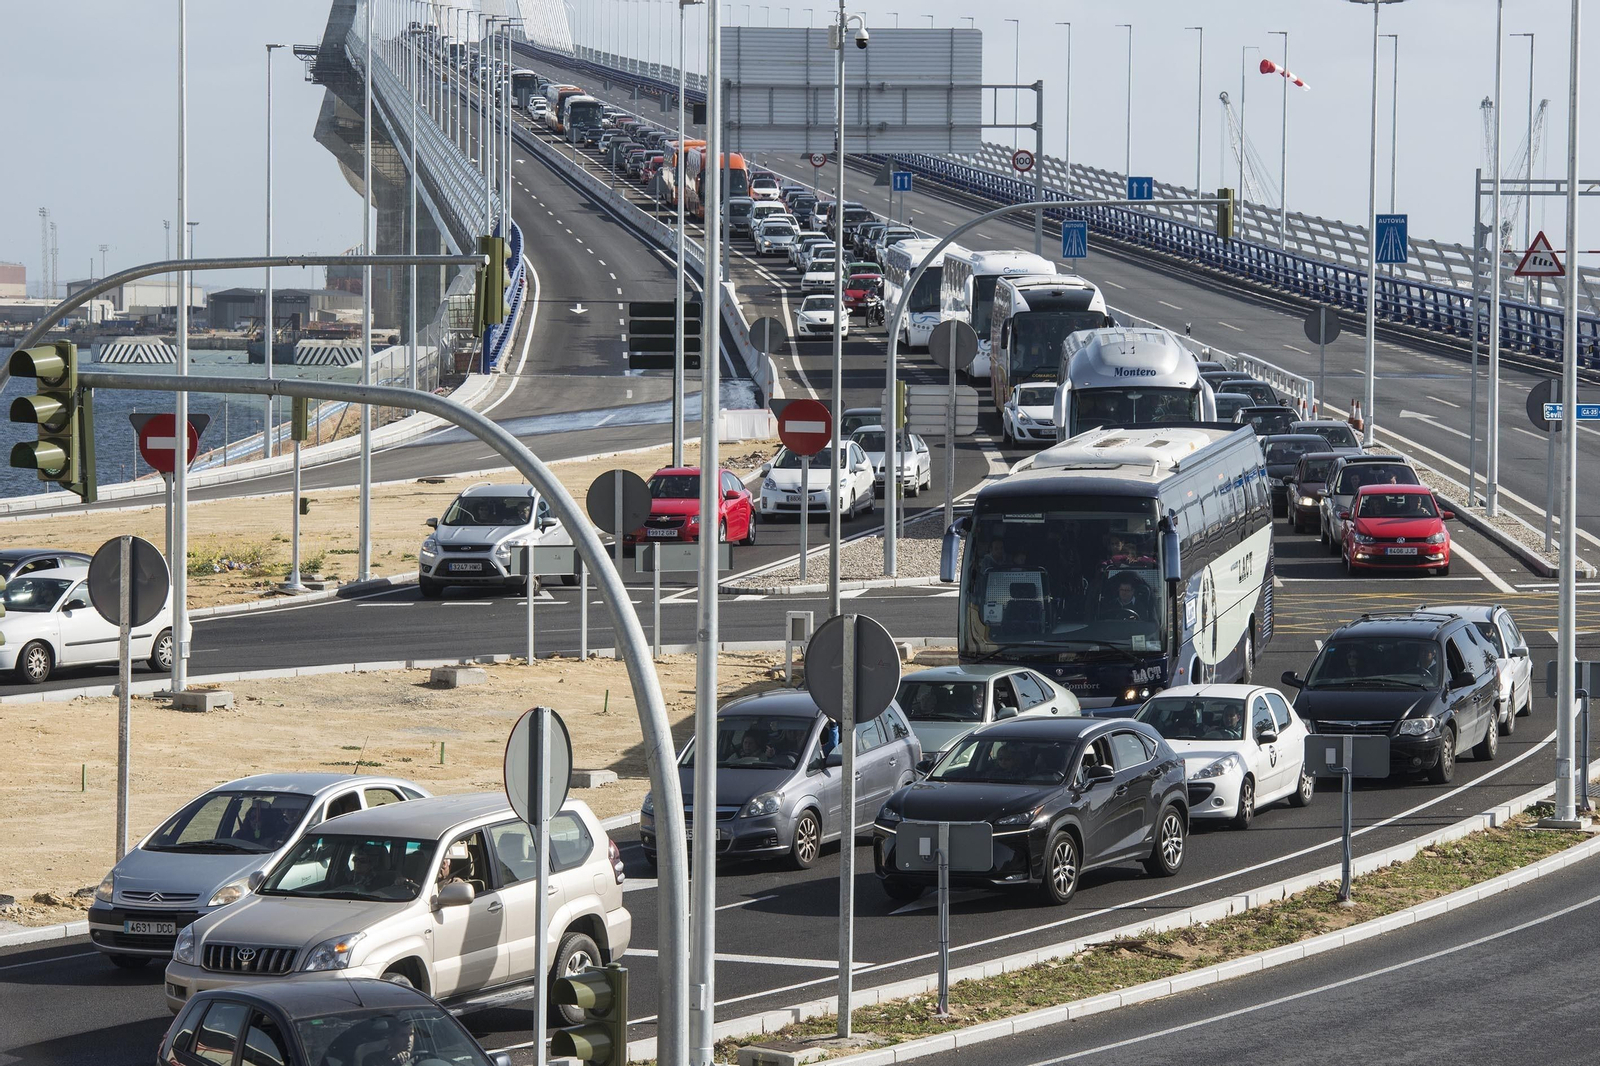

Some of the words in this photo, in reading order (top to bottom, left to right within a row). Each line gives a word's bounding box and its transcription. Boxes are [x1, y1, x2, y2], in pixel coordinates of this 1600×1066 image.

[1016, 157, 1030, 165] 100
[1114, 367, 1157, 377] Montero
[1238, 551, 1253, 583] LACT
[1132, 666, 1162, 683] LACT
[1062, 681, 1100, 691] Comfort
[131, 922, 151, 933] 4631
[157, 924, 173, 934] DCC
